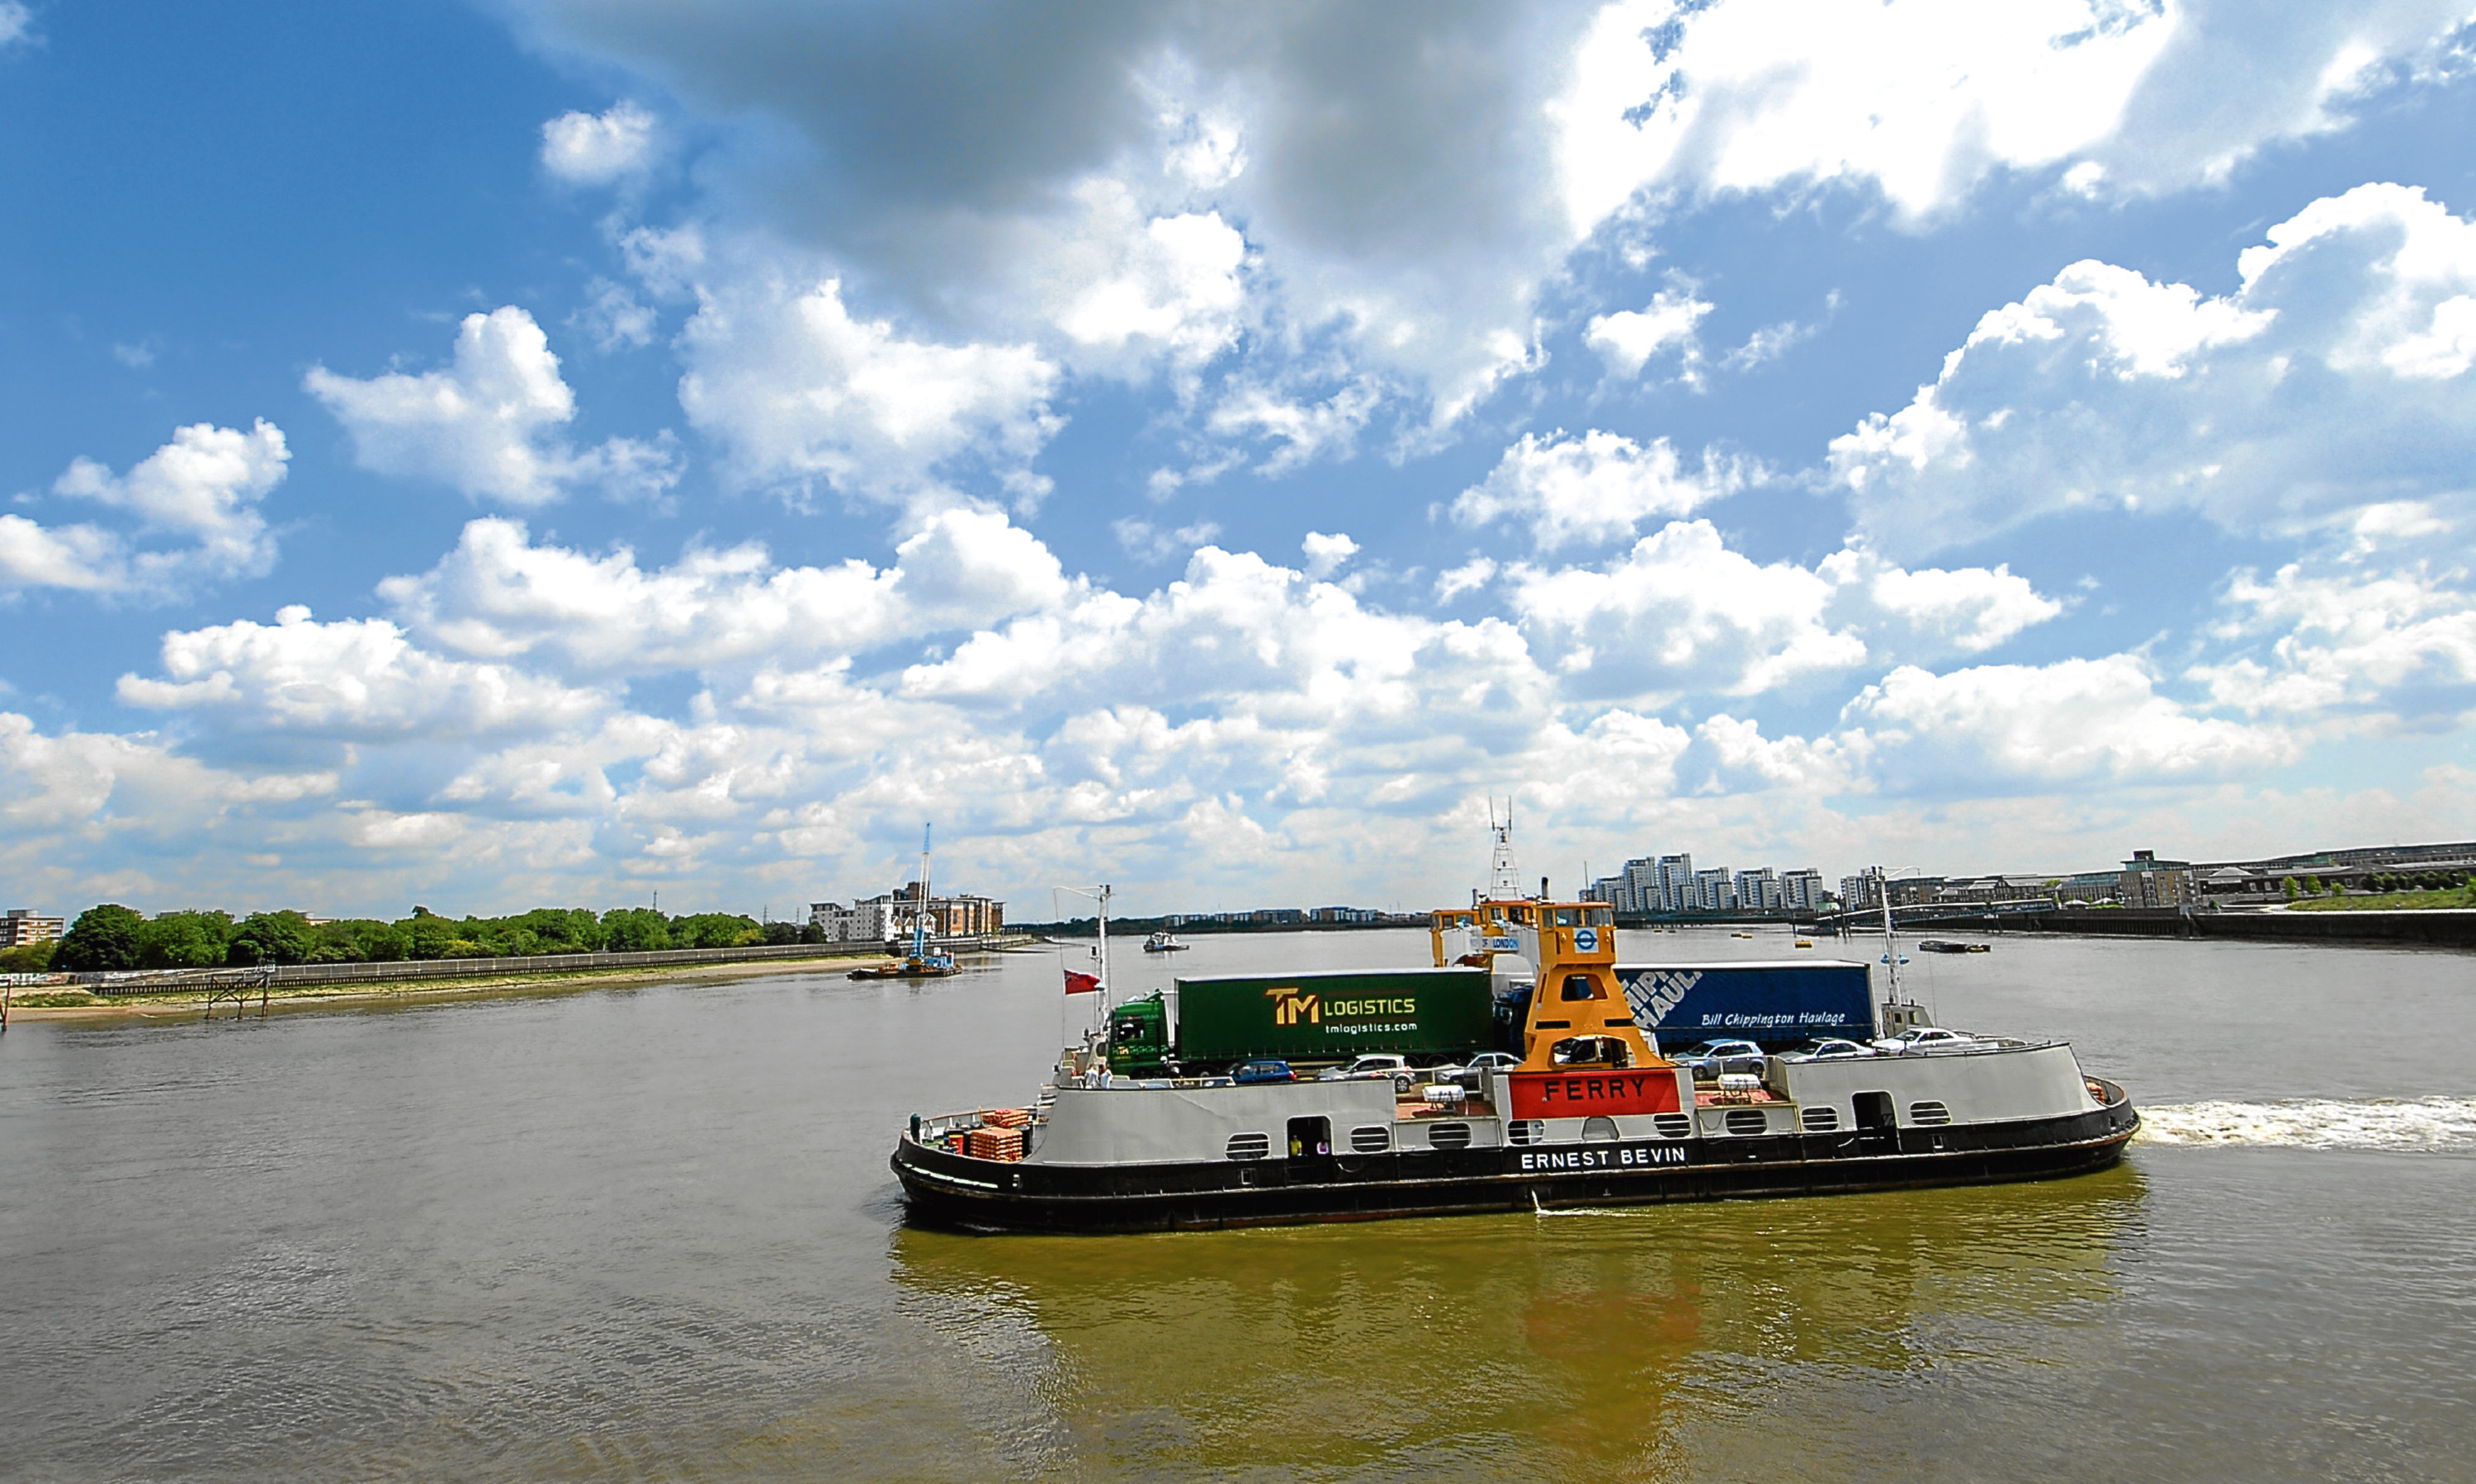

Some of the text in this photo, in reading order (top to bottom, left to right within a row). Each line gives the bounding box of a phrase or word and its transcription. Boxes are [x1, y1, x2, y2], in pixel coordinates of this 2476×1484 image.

[1493, 938, 1519, 948] LONDON
[1265, 988, 1320, 1024] TM
[1325, 999, 1415, 1016] LOGISTICS
[1701, 1011, 1845, 1028] Bill Chippington Haulage
[1325, 1023, 1417, 1034] tmlogistics.com
[1544, 1077, 1644, 1101] FERRY
[1521, 1147, 1685, 1169] ERNEST BEVIN
